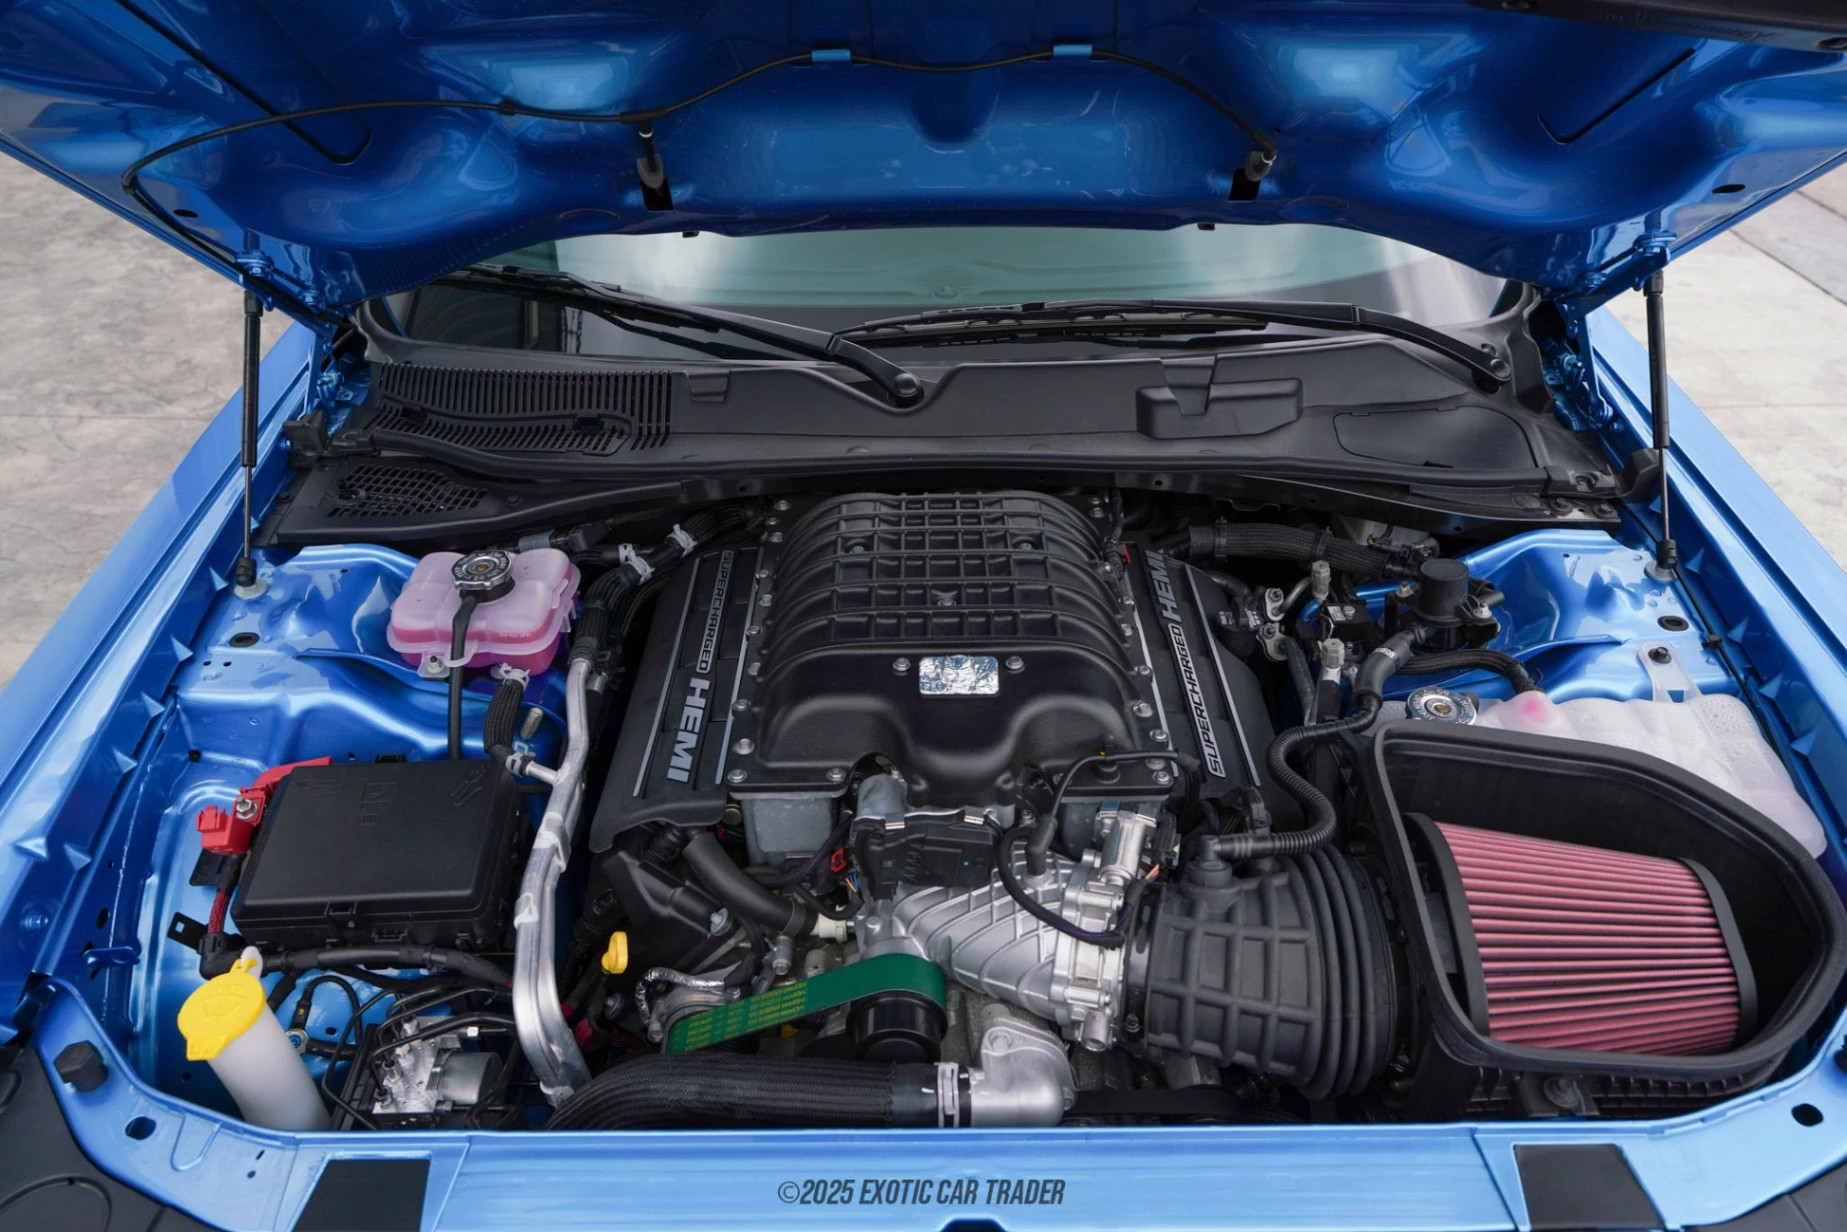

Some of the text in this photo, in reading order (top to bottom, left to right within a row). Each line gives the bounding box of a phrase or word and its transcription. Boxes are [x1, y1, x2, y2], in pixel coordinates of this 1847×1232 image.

[667, 551, 733, 783] SUPERCHARGED HEMI
[1145, 550, 1224, 776] HEMI SUPERCHARGED
